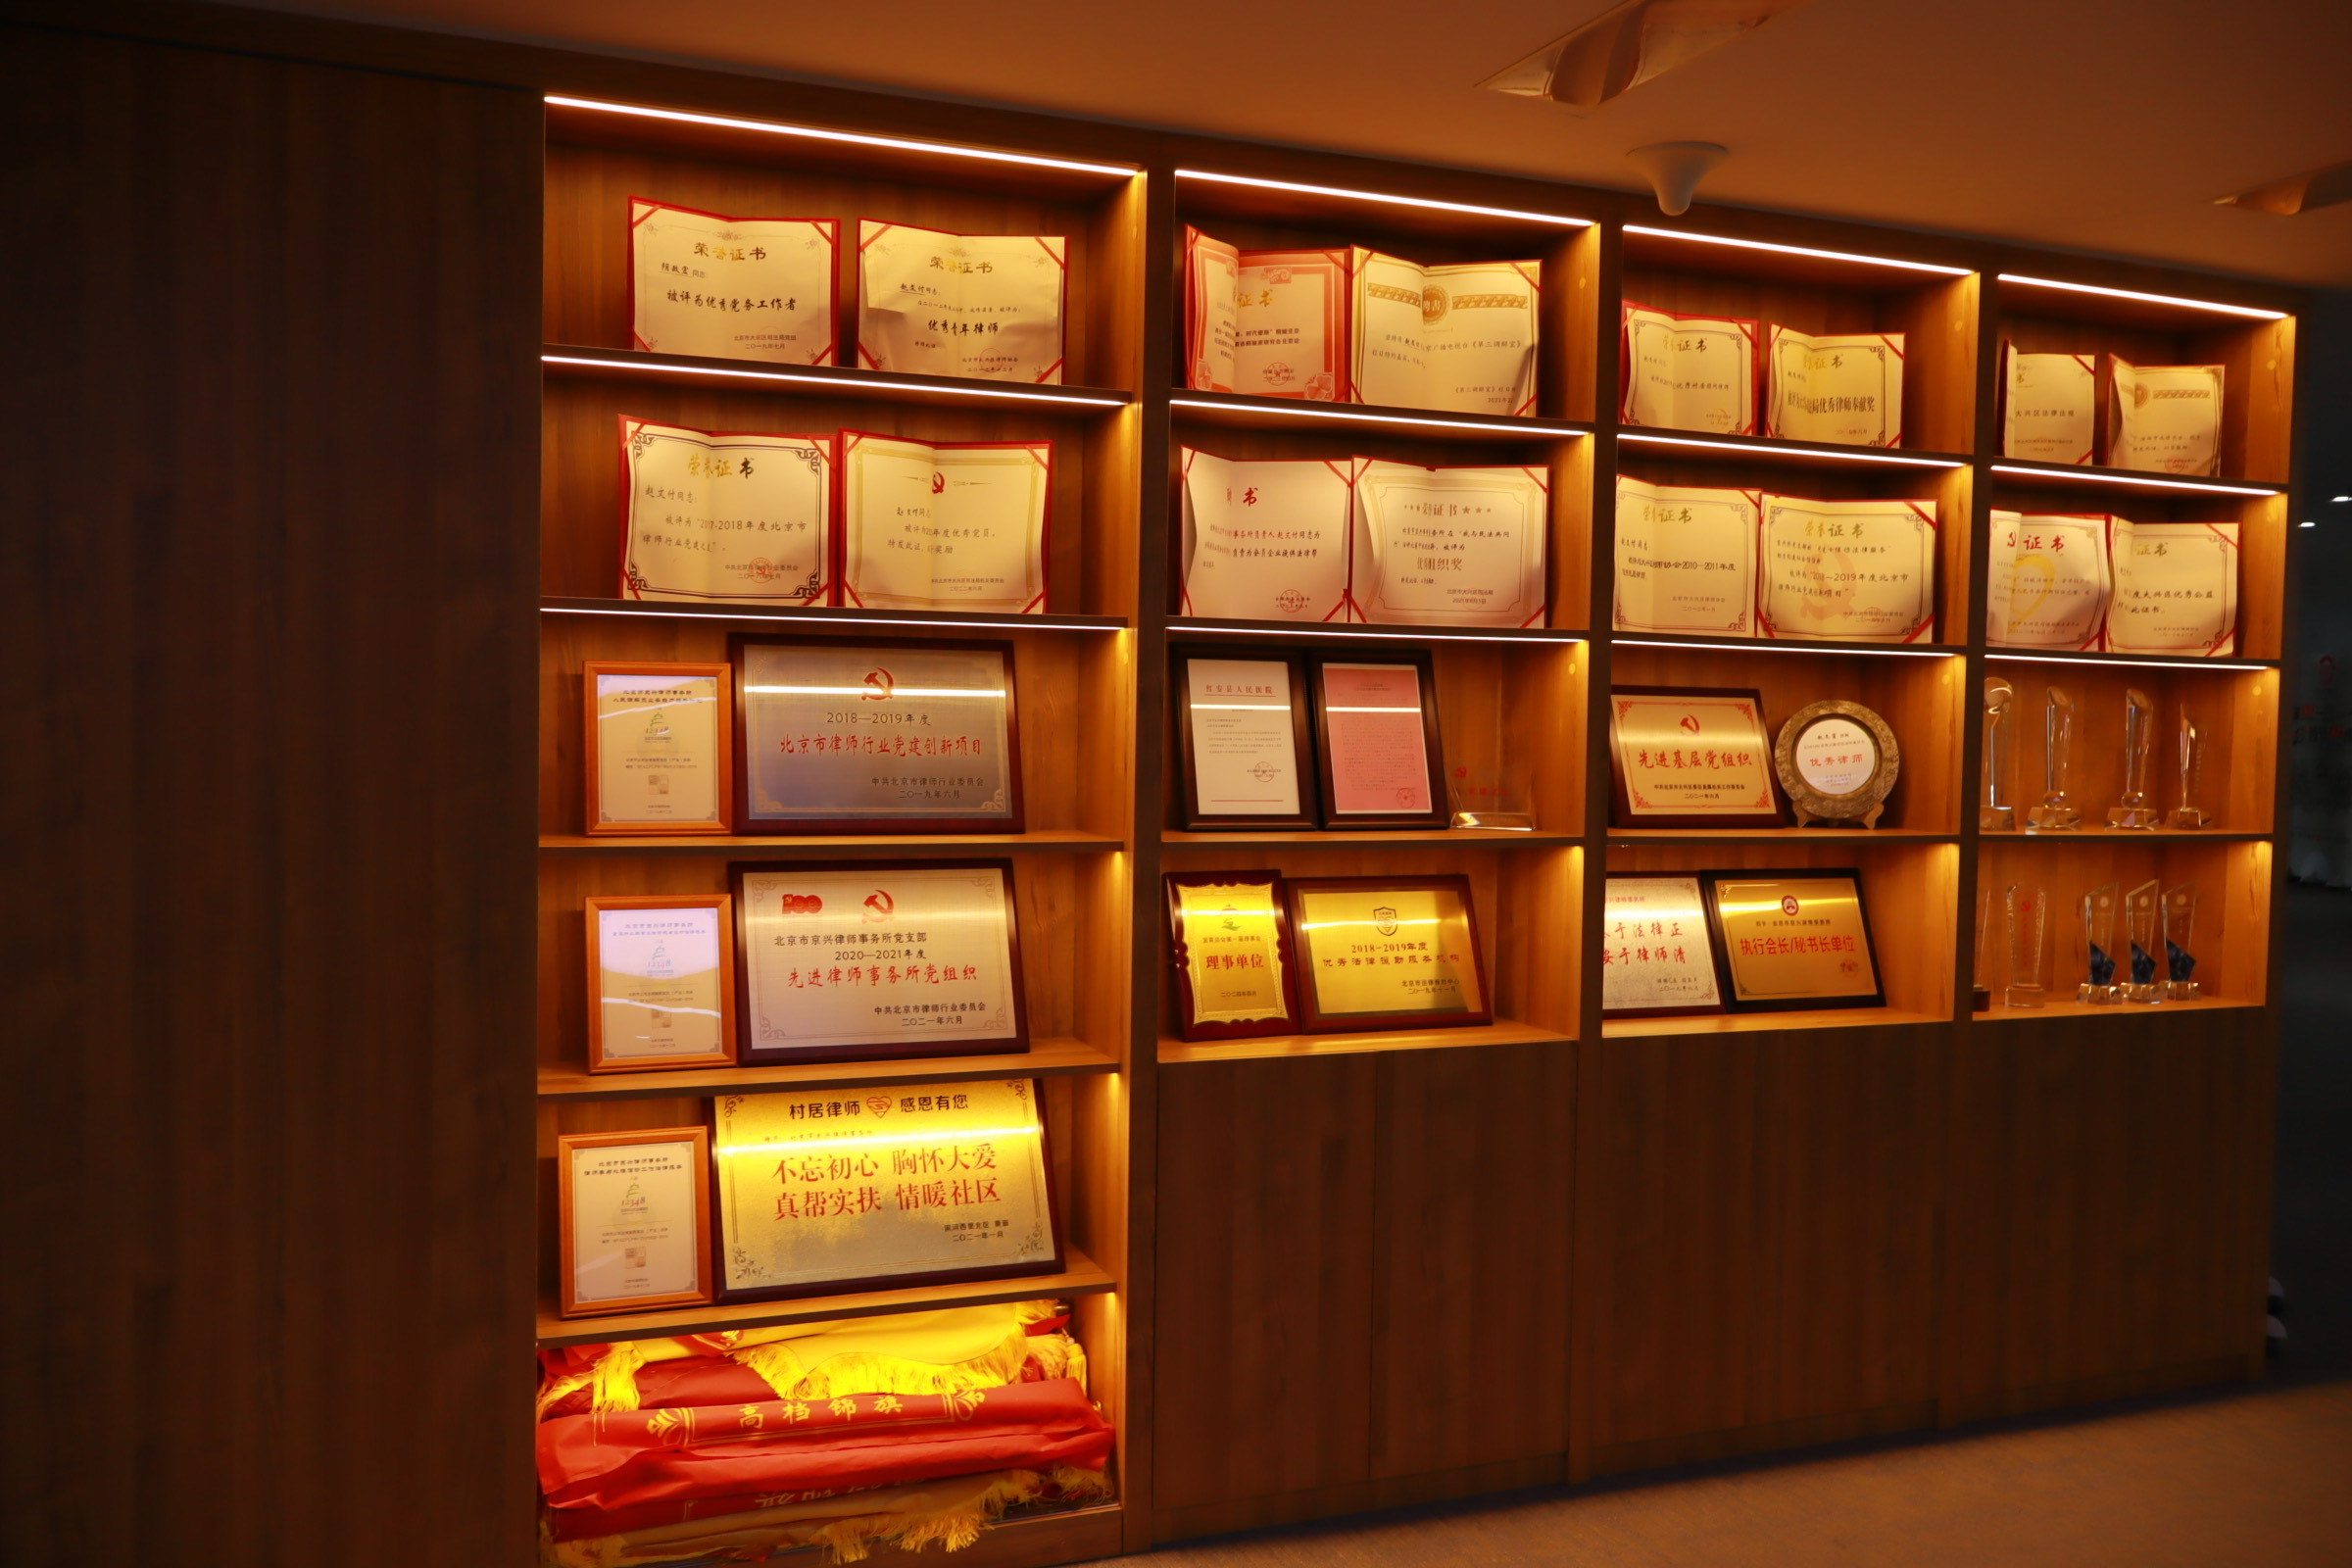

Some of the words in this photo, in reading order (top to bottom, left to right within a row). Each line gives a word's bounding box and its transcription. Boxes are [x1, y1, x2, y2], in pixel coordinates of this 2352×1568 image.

[693, 241, 767, 262] 荣誉证书
[666, 289, 798, 313] 被评为优秀党务工作者
[688, 454, 755, 479] 荣誉证书
[780, 734, 982, 758] 北京市律师行业党建创新项目
[1638, 749, 1753, 770] 先进基层党组织
[774, 932, 927, 947] 北京市京兴律师事务所党支部
[1740, 936, 1856, 956] 执行会长/秘书长单位
[1205, 954, 1265, 970] 理事单位
[1322, 954, 1460, 967] 优秀法律援助服务机构
[787, 962, 978, 989] 先进律师事务所党组织
[873, 1002, 986, 1015] 中共北京市律师行业委员会
[789, 1100, 860, 1120] 村居律师
[900, 1094, 969, 1113] 感恩有您
[772, 1152, 879, 1185] 不忘初心
[892, 1142, 998, 1176] 胸怀大爱
[774, 1186, 883, 1221] 真帮实扶
[896, 1177, 1002, 1212] 情暖社区
[737, 1395, 905, 1431] 高档锦旗
